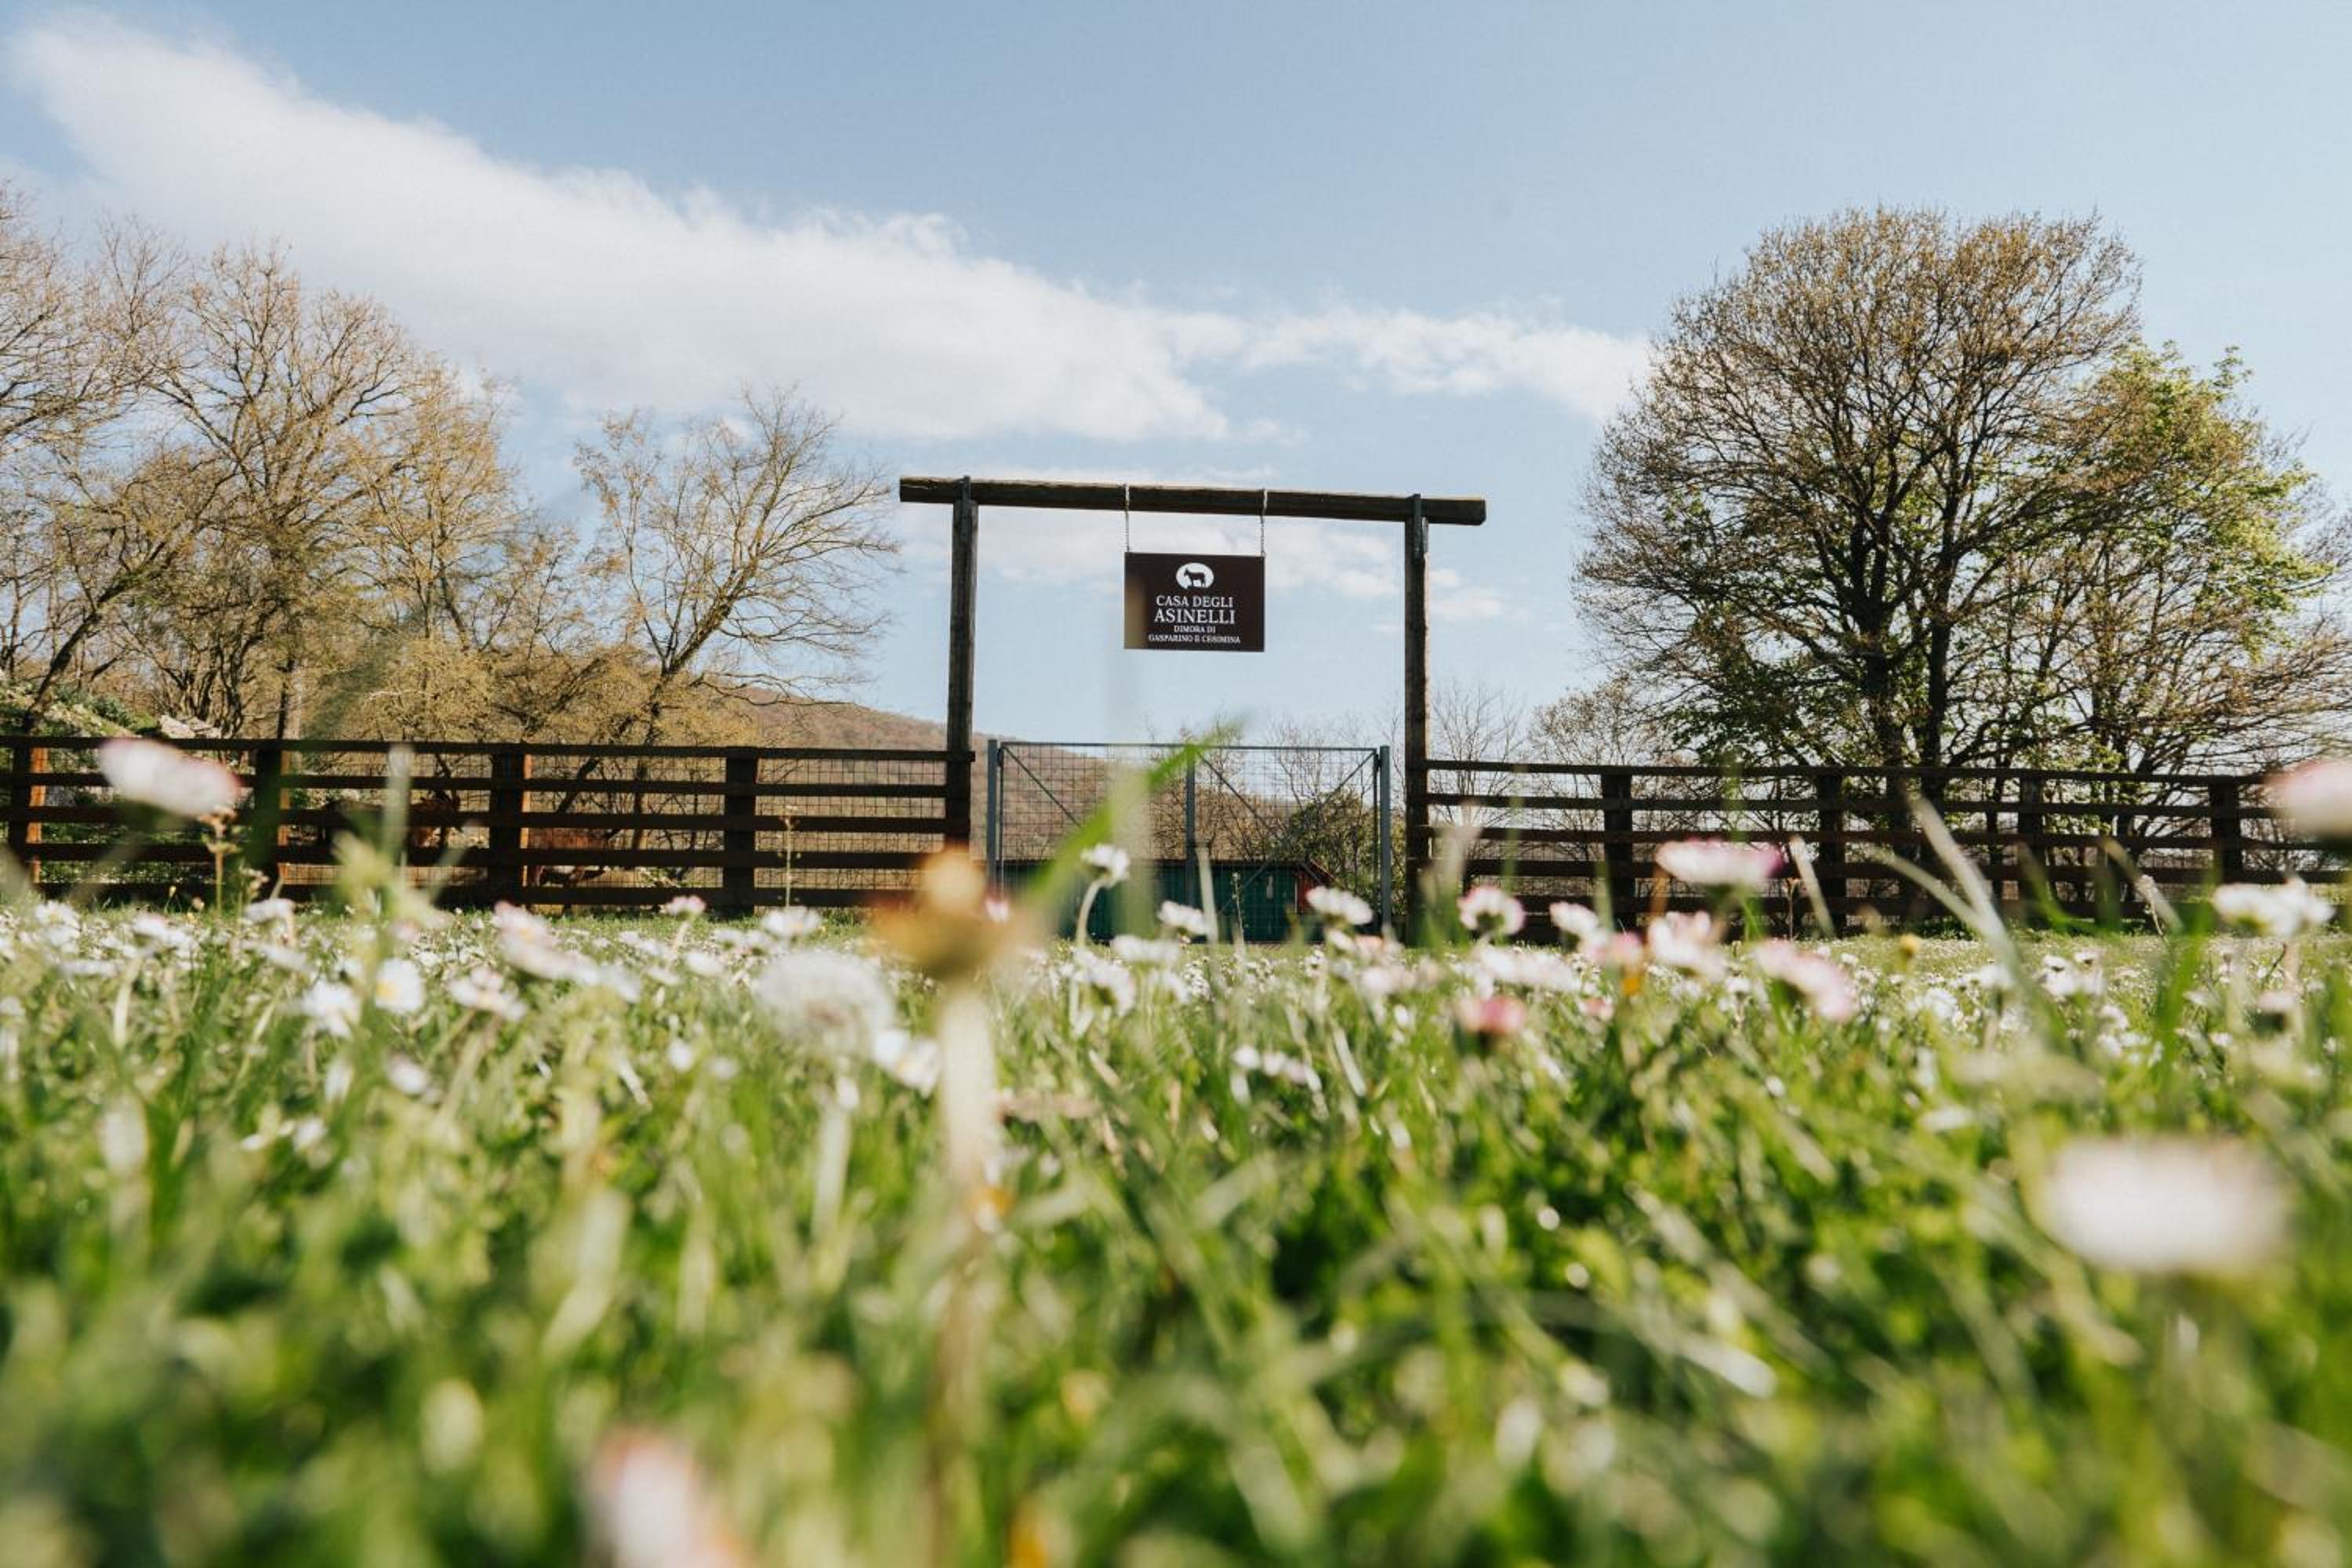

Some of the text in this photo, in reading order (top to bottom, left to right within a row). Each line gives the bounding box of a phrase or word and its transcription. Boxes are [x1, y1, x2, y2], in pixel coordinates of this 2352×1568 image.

[1156, 595, 1233, 608] CASA DEGLI
[1154, 608, 1236, 624] ASINELLI
[1148, 633, 1193, 642] GASPARINO
